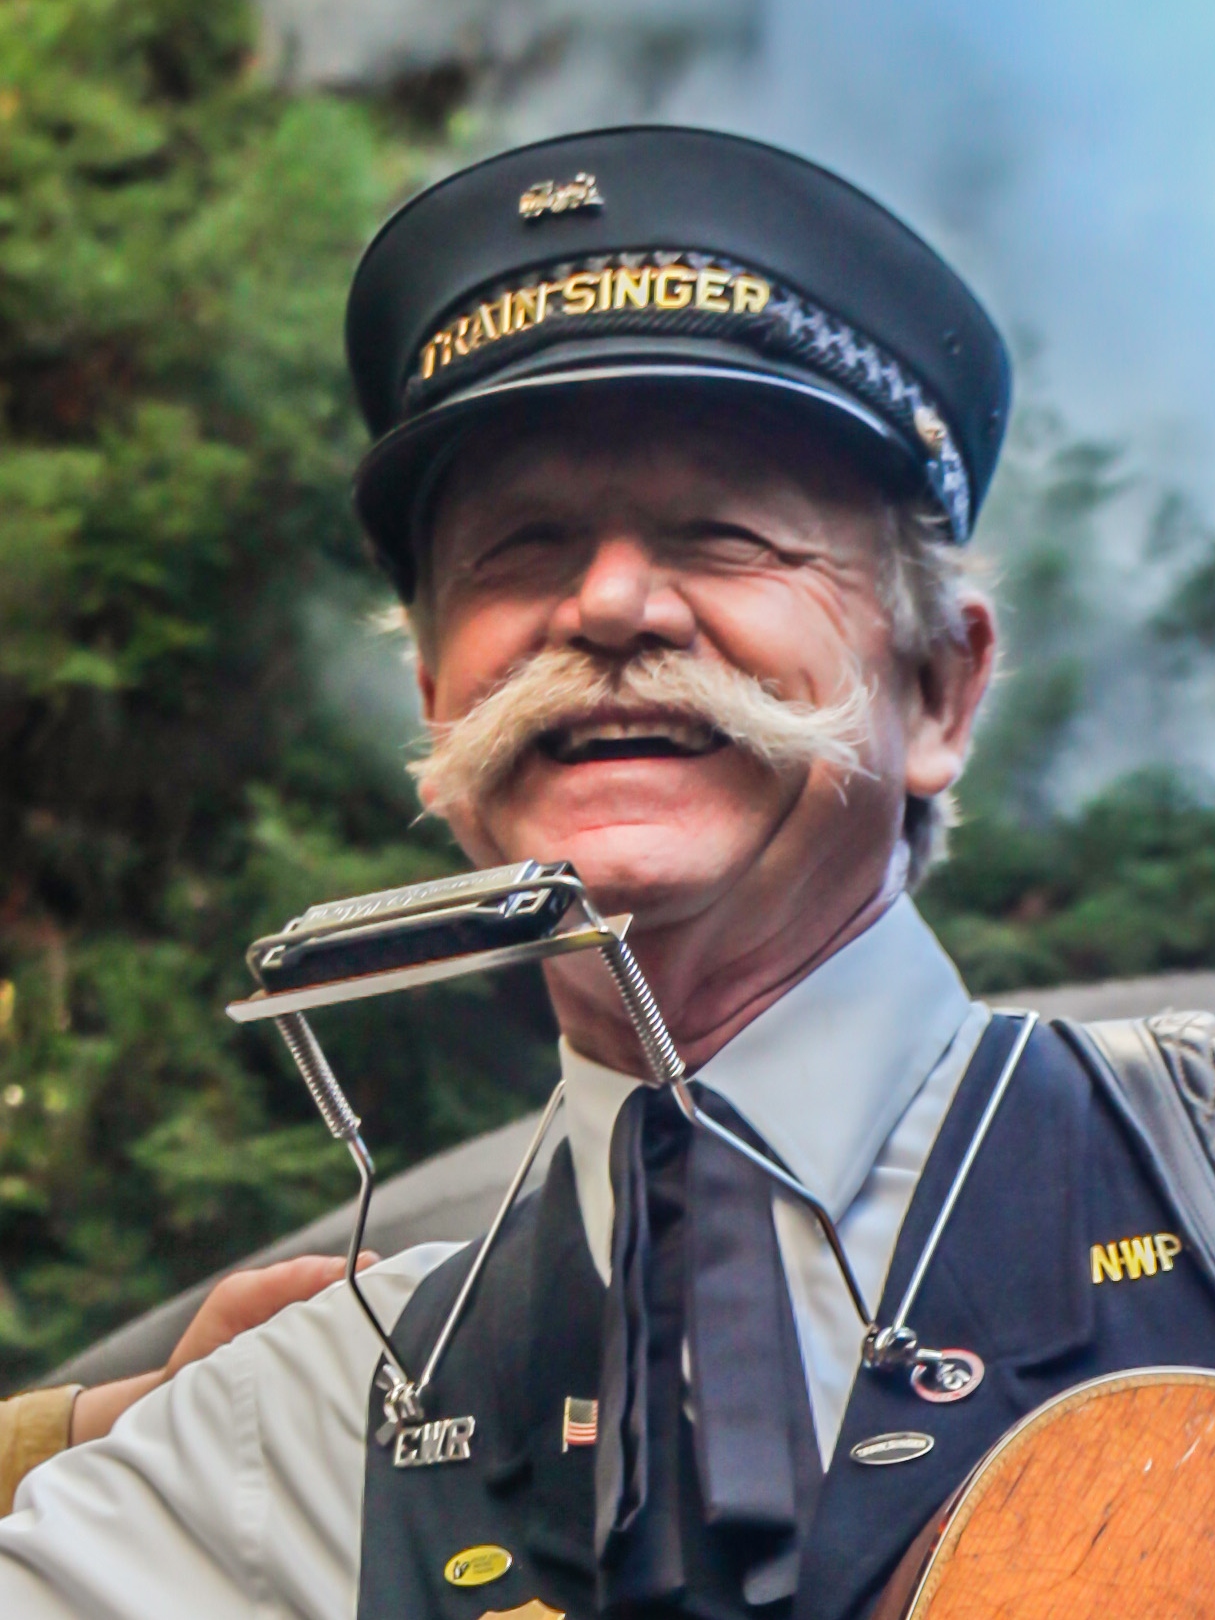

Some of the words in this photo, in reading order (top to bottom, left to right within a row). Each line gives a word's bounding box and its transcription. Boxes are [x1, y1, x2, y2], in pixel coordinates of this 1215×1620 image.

[421, 281, 548, 379] TRAIN
[562, 267, 770, 314] SINGER
[1090, 1232, 1182, 1284] NWP
[393, 1416, 475, 1468] CWR
